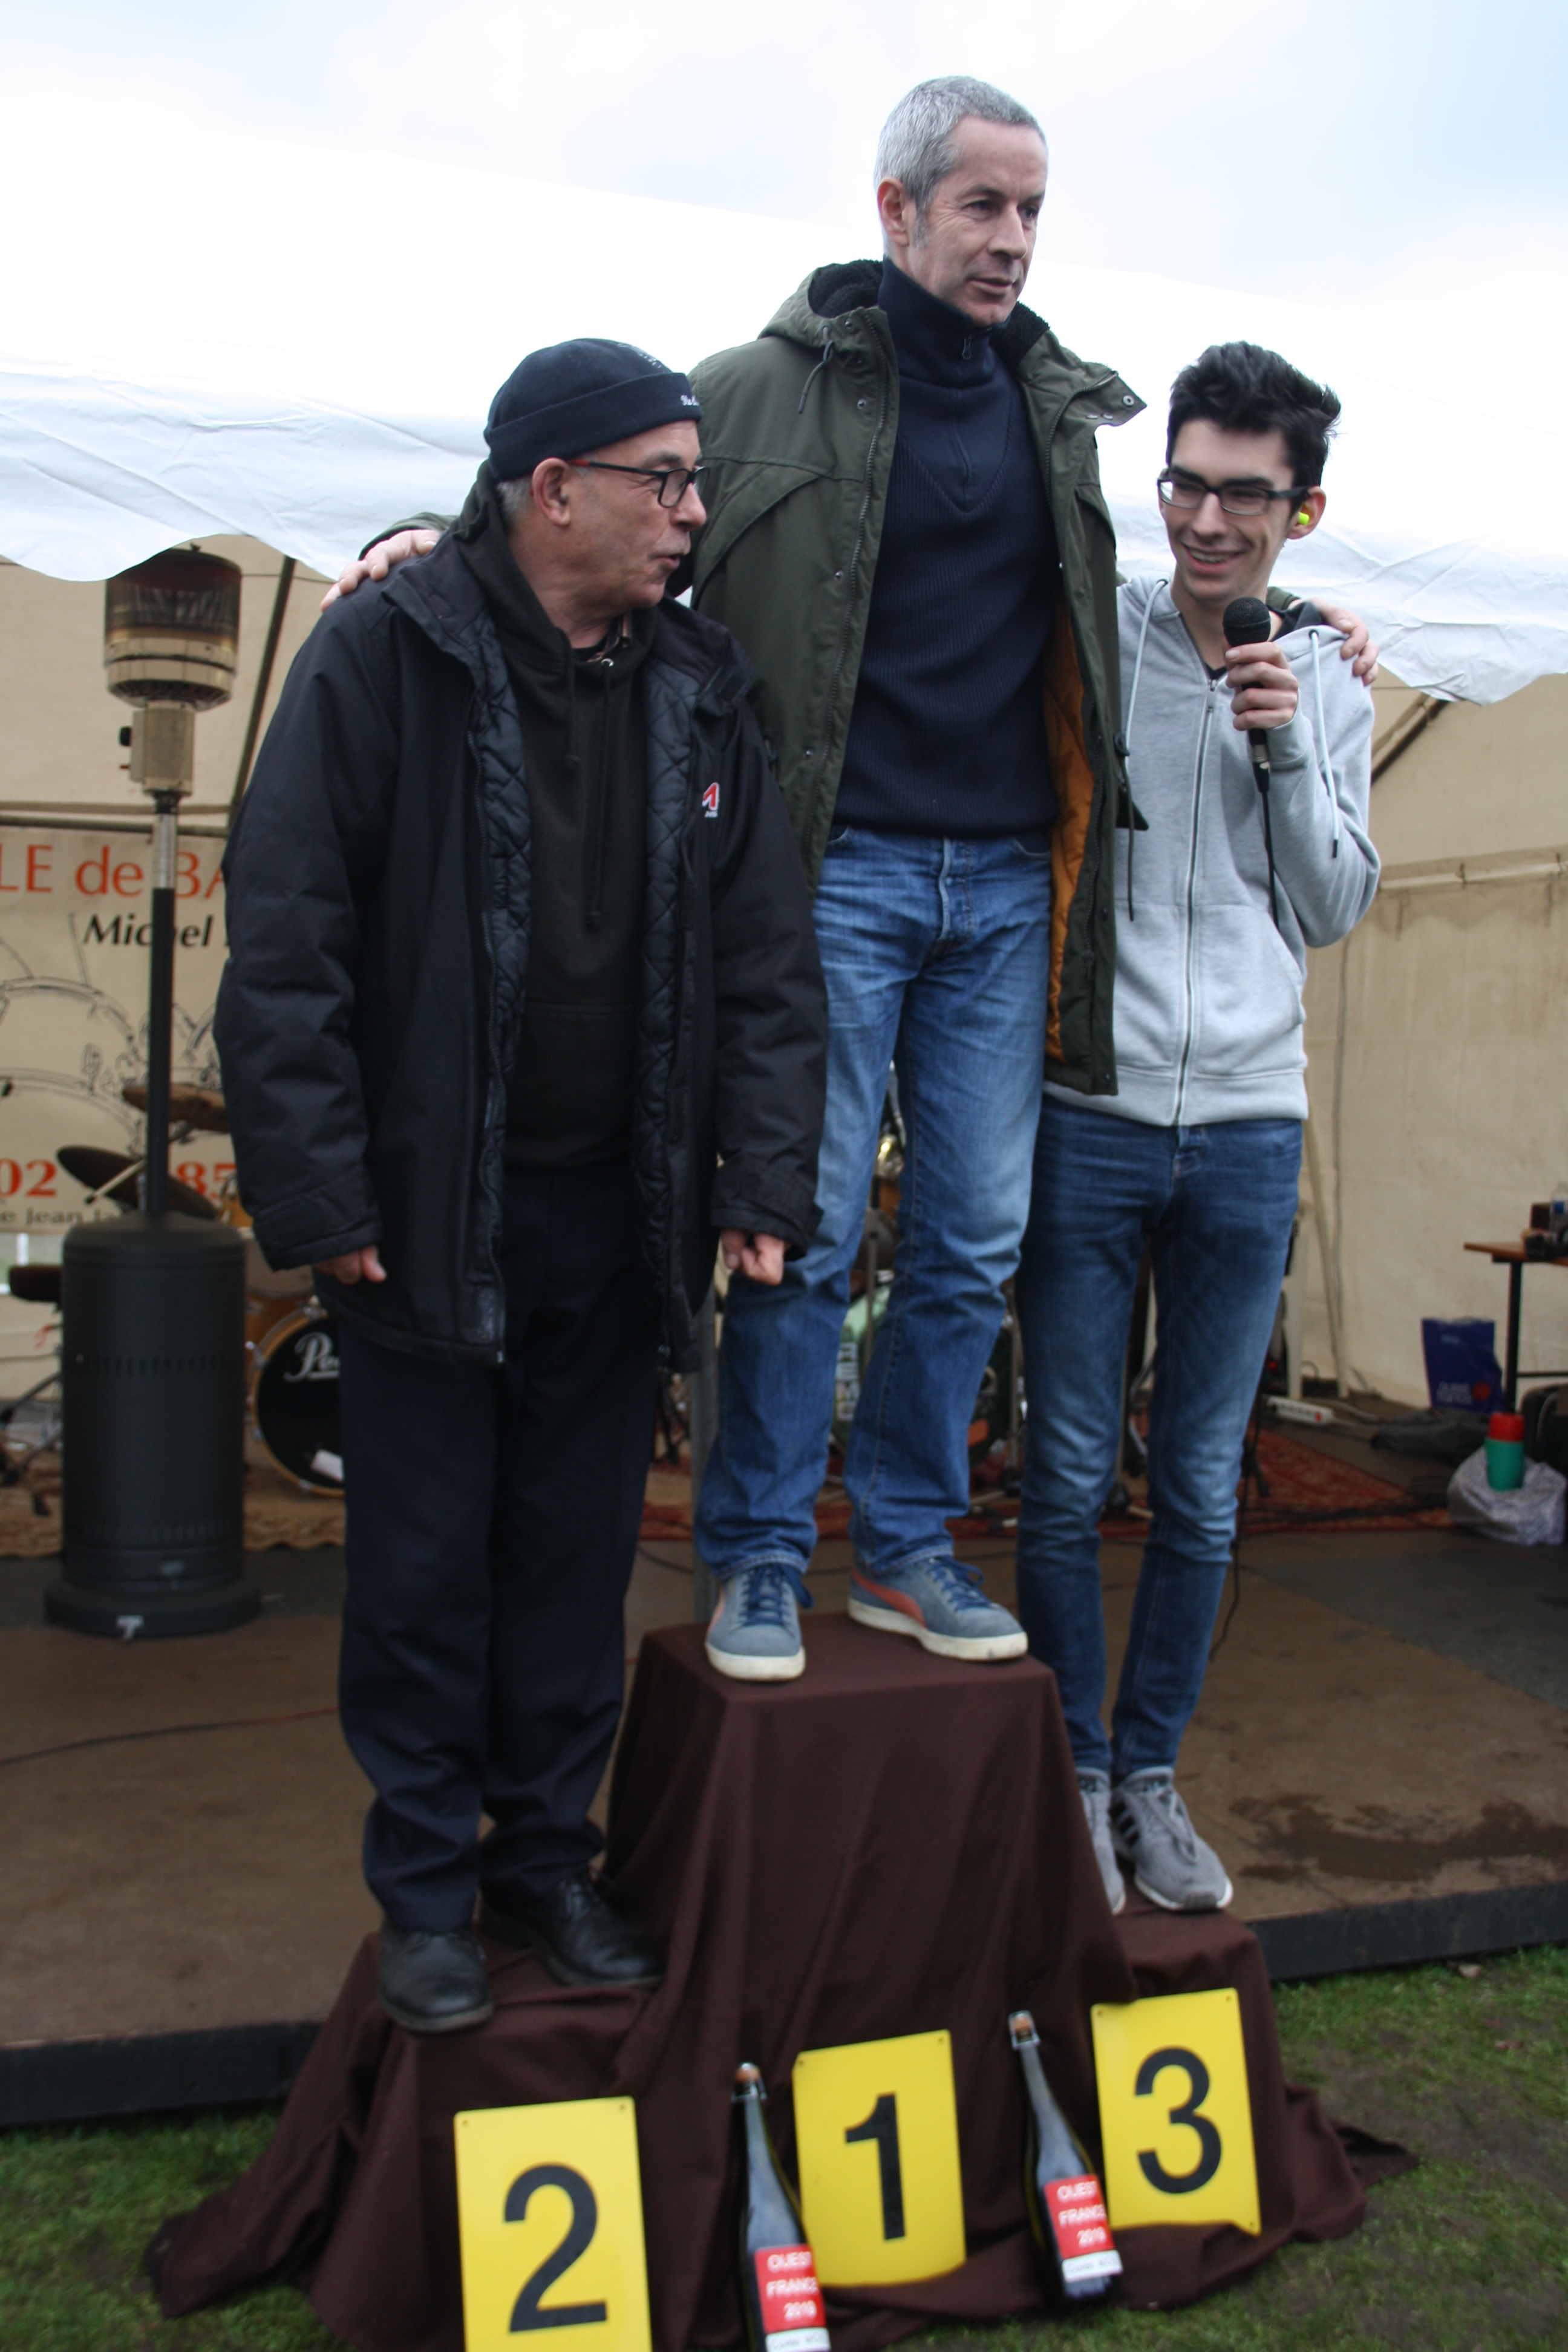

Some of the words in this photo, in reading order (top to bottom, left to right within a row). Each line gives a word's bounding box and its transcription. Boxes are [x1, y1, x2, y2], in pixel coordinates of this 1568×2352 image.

[75, 845, 143, 897] de
[83, 913, 214, 947] Micel
[1135, 2048, 1221, 2194] 3
[844, 2092, 905, 2241] 1
[1059, 2204, 1106, 2227] FRANCE
[505, 2164, 607, 2332] 2
[766, 2277, 819, 2300] FRANCE
